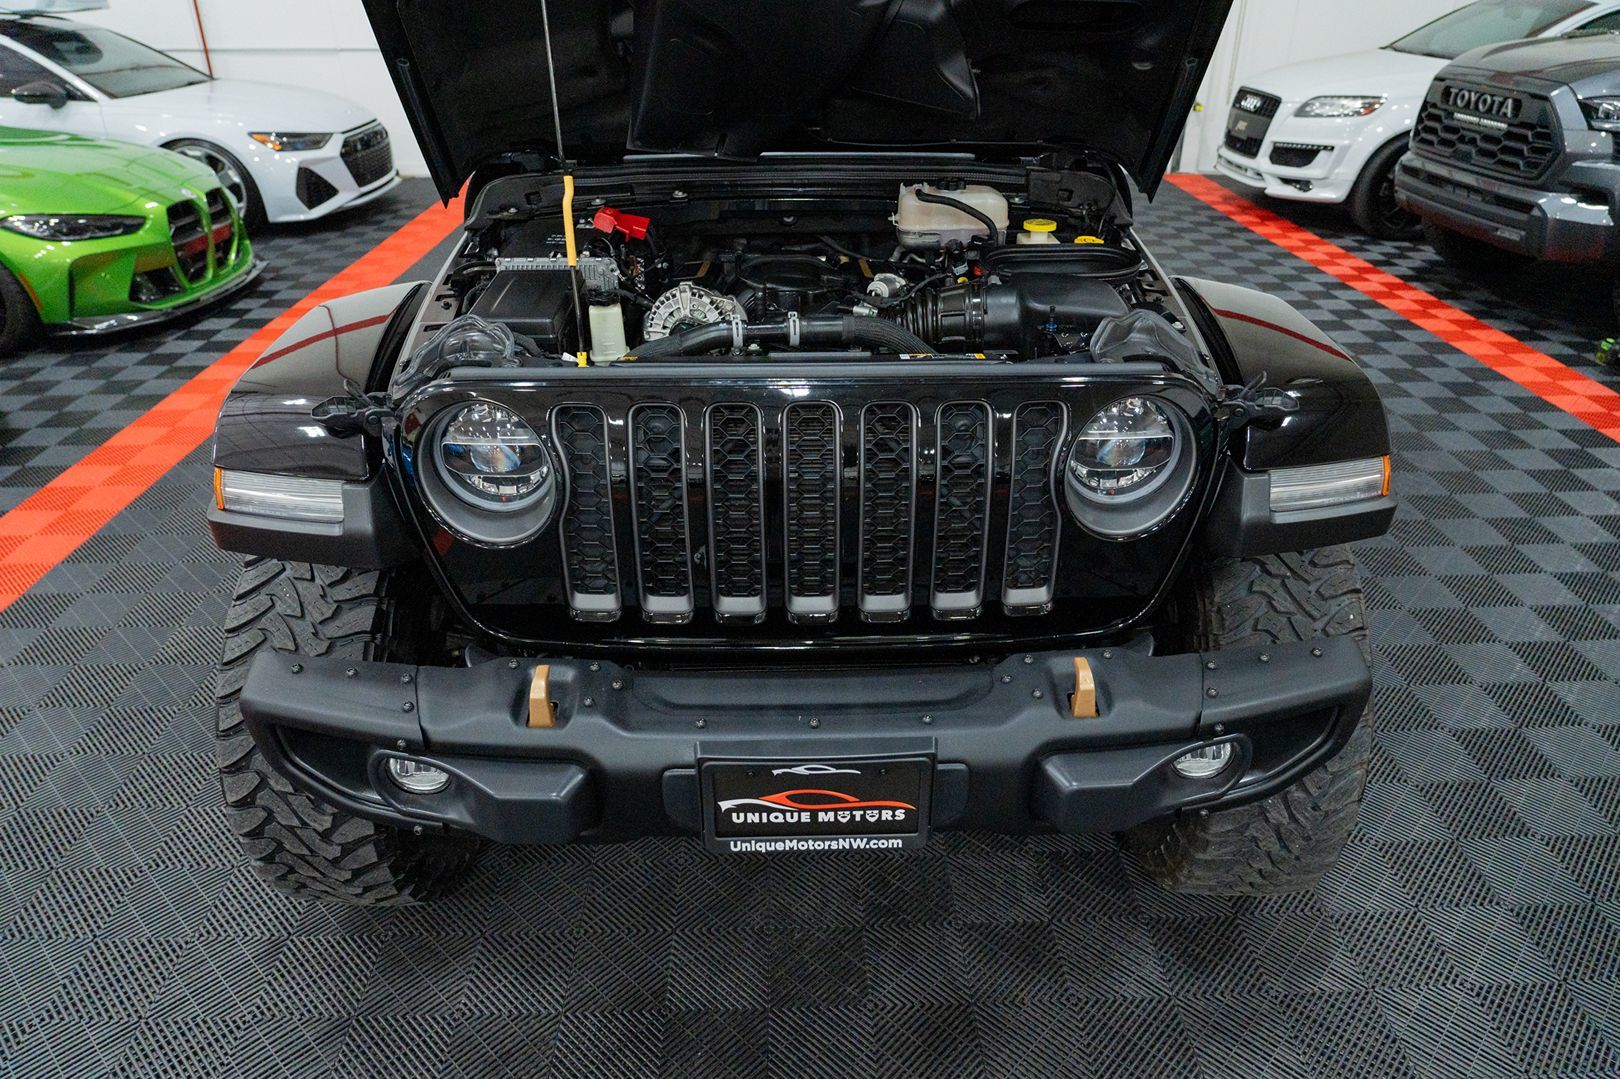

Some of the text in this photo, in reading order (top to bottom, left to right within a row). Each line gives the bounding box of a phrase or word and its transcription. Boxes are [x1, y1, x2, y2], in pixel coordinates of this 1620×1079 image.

[1449, 87, 1513, 118] TOYOTA
[731, 809, 906, 824] UNIQUE MOTORS
[730, 838, 903, 853] UniqueMotorsNW.com
